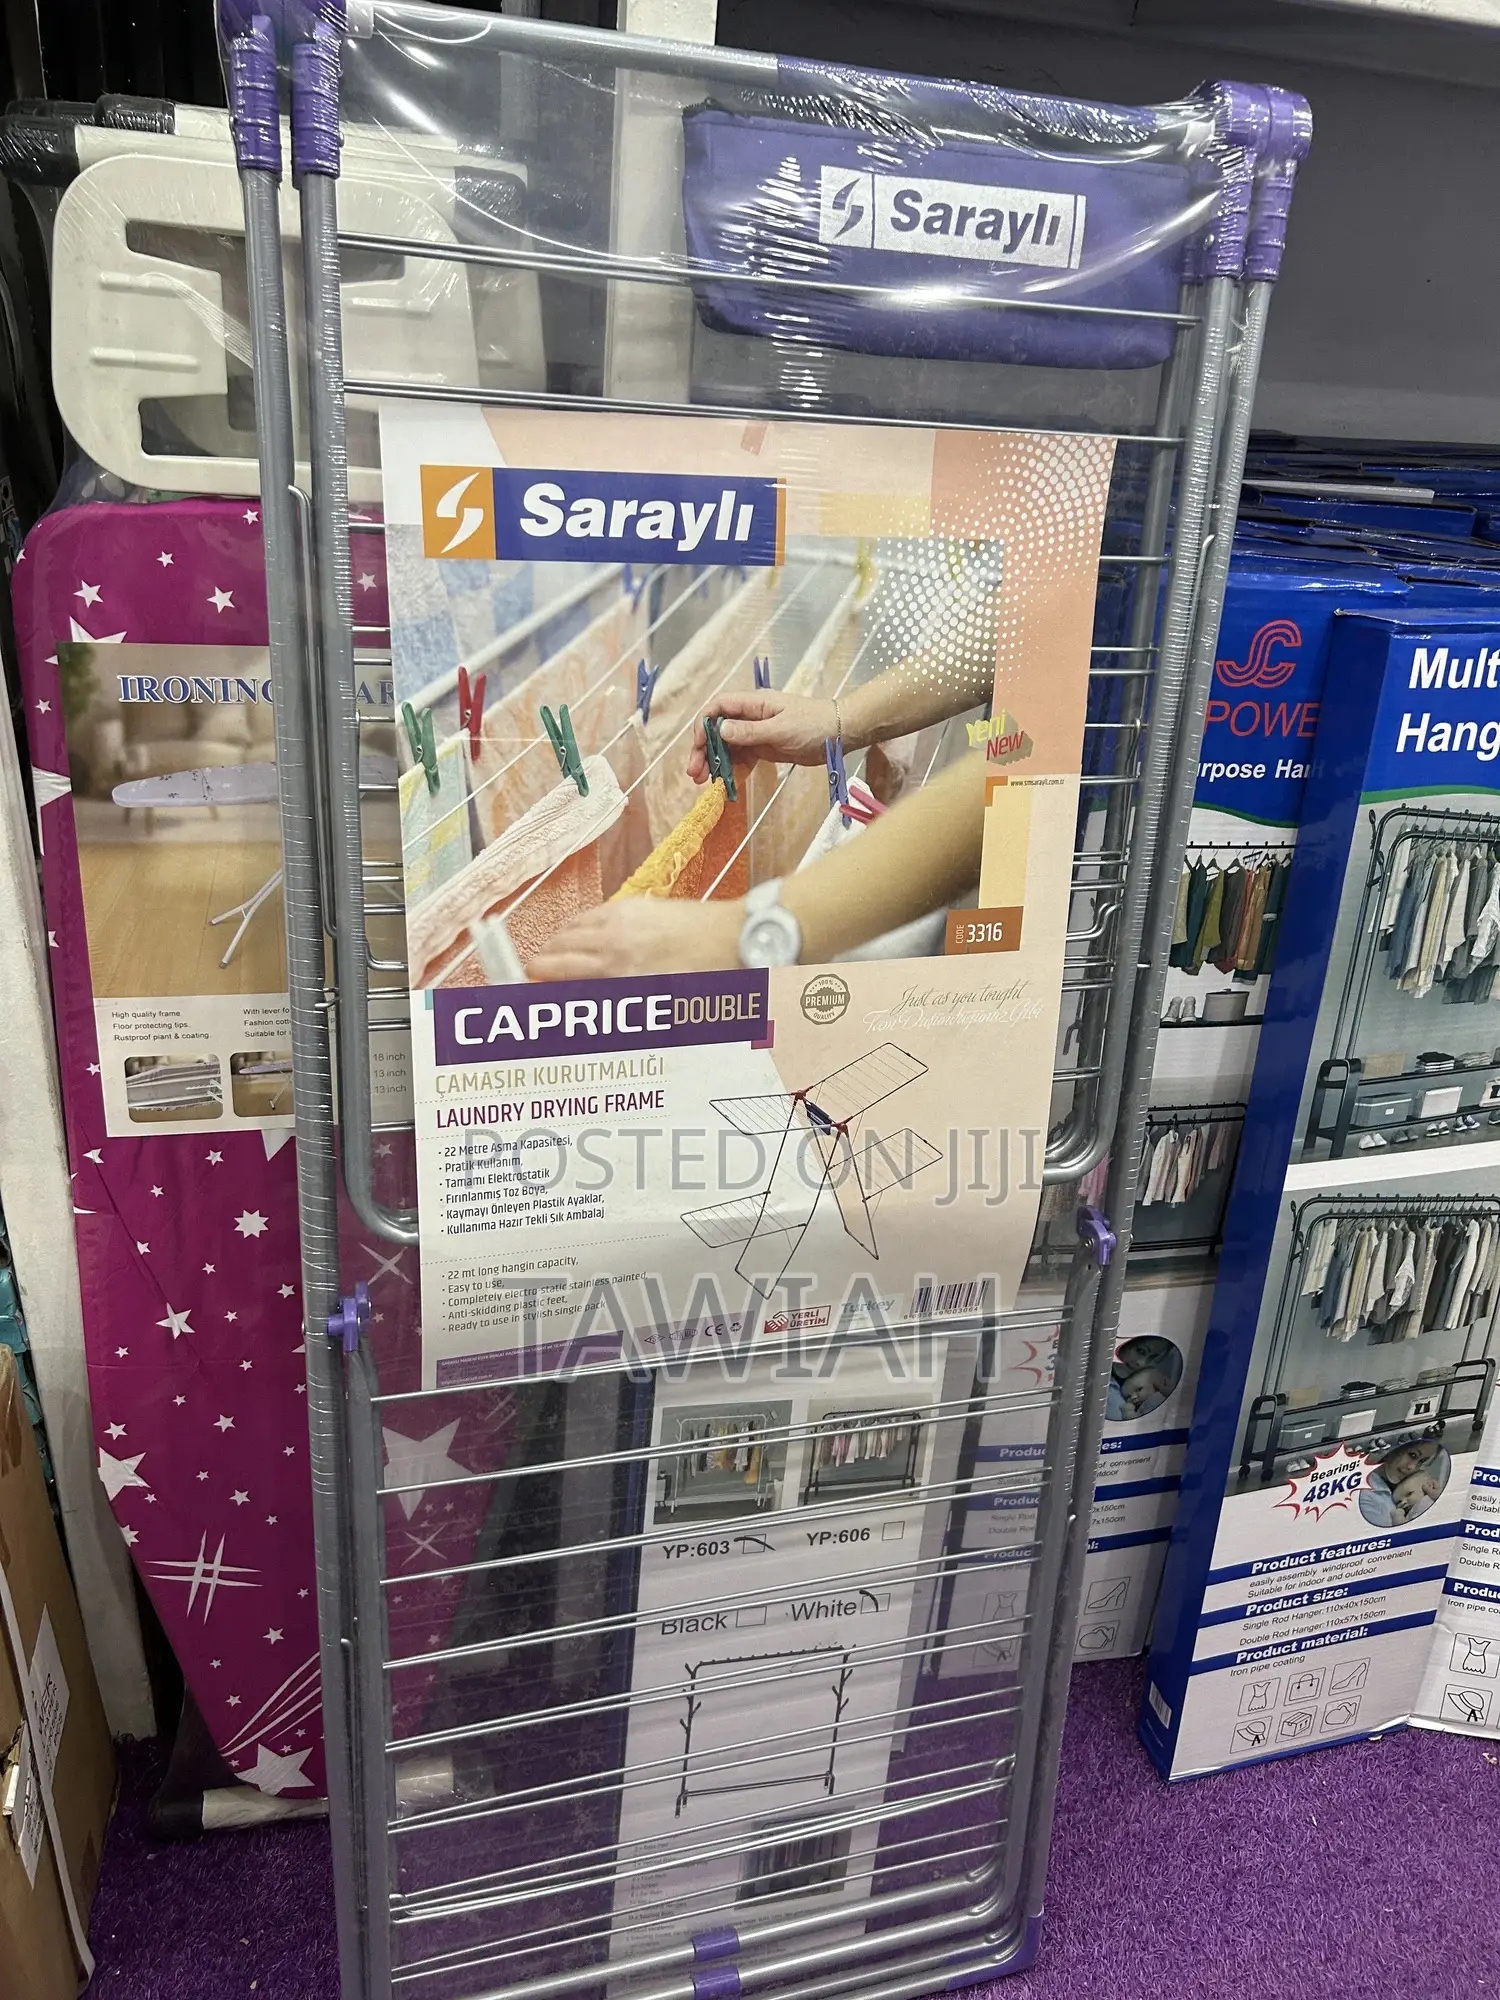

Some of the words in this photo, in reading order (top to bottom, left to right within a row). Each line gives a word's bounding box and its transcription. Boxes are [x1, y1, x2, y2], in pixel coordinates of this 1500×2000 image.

[890, 188, 1061, 254] Saraylı
[520, 482, 755, 552] Saraylı
[1408, 647, 1500, 689] Mult
[1203, 700, 1320, 738] POWE
[1395, 712, 1500, 762] Hang
[955, 924, 965, 944] CODE
[966, 922, 1003, 943] 3316
[805, 993, 845, 1007] PREMIUM
[932, 992, 951, 1007] as
[952, 991, 977, 1013] you
[111, 1011, 130, 1020] High
[131, 1011, 157, 1019] quality
[158, 1010, 181, 1018] frame
[243, 1008, 260, 1016] With
[261, 1007, 282, 1015] lever
[453, 993, 672, 1046] CAPRICE
[673, 991, 762, 1026] DOUBLE
[813, 1011, 835, 1020] QUALITY
[134, 1022, 173, 1030] protecting
[243, 1018, 275, 1027] Fashion
[114, 1033, 152, 1042] Rustproof
[174, 1032, 180, 1040] &
[244, 1029, 275, 1038] Suitable
[276, 1029, 288, 1037] for
[373, 1053, 385, 1062] 18
[386, 1052, 406, 1061] inch
[374, 1069, 386, 1078] 13
[387, 1068, 407, 1078] inch
[435, 1067, 527, 1099] ÇAMAŞIR
[533, 1054, 665, 1087] KURUTMALIĞI
[374, 1085, 386, 1094] 13
[387, 1084, 407, 1094] inch
[436, 1100, 526, 1129] LAUNDRY
[530, 1095, 599, 1121] DRYING
[604, 1089, 665, 1114] FRAME
[444, 1146, 457, 1157] 22
[459, 1143, 489, 1156] Metre
[490, 1141, 518, 1153] Asma
[520, 1134, 573, 1150] Kapasitesi,
[445, 1160, 475, 1173] Pratik
[445, 1175, 486, 1188] Tamamı
[488, 1168, 550, 1184] Elektrostatik
[446, 1189, 501, 1204] Fırınlanmış
[503, 1186, 520, 1198] Toz
[522, 1184, 548, 1197] Boya,
[446, 1207, 489, 1220] Kaymayı
[491, 1202, 530, 1216] Önleyen
[533, 1197, 565, 1209] Plastik
[567, 1192, 605, 1207] Ayaklar,
[447, 1219, 496, 1235] Kullanıma
[499, 1216, 524, 1229] Hazır
[525, 1213, 548, 1226] Tekli
[566, 1206, 605, 1221] Ambalaj
[448, 1270, 459, 1280] 22
[462, 1268, 476, 1278] mt
[478, 1265, 499, 1277] long
[502, 1261, 535, 1275] hangin
[537, 1255, 579, 1270] capacity,
[448, 1282, 470, 1294] Easy
[472, 1280, 483, 1290] to
[448, 1291, 502, 1307] Completely
[569, 1277, 610, 1291] stainless
[448, 1303, 512, 1320] Anti-skidding
[513, 1298, 545, 1312] plastic
[547, 1294, 568, 1305] feet,
[791, 1308, 820, 1320] YERLİ
[841, 1299, 896, 1313] Turkey
[448, 1320, 478, 1333] Ready
[480, 1318, 490, 1328] to
[492, 1315, 509, 1326] use
[511, 1313, 520, 1323] in
[522, 1308, 553, 1321] stylish
[555, 1304, 583, 1317] single
[789, 1316, 826, 1328] ÜRETİM
[999, 1446, 1046, 1458] Produc
[1309, 1459, 1361, 1483] Bearing:
[1302, 1471, 1362, 1503] 48KG
[993, 1495, 1040, 1507] Produc
[1471, 1494, 1497, 1505] easily
[1464, 1523, 1500, 1538] Prod
[662, 1540, 731, 1560] YP:603
[806, 1527, 872, 1547] YP:606
[1461, 1543, 1490, 1555] Single
[1251, 1552, 1317, 1575] Product
[1320, 1537, 1392, 1562] features:
[1459, 1557, 1491, 1569] Double
[1249, 1575, 1275, 1588] easily
[1276, 1567, 1318, 1583] assembly
[1322, 1558, 1364, 1574] windproof
[1367, 1548, 1413, 1565] convenient
[1247, 1585, 1283, 1599] Suitable
[1284, 1581, 1297, 1591] for
[1298, 1575, 1325, 1588] indoor
[1326, 1571, 1344, 1583] and
[1345, 1566, 1378, 1579] outdoor
[1245, 1594, 1309, 1616] Product
[1312, 1586, 1349, 1603] size:
[1447, 1598, 1465, 1609] Iron
[1466, 1601, 1486, 1613] pipe
[660, 1612, 729, 1636] Black
[791, 1600, 858, 1622] White
[1242, 1619, 1270, 1631] Single
[1271, 1614, 1290, 1625] Rod
[1235, 1642, 1298, 1664] Product
[1300, 1626, 1369, 1650] material:
[1239, 1634, 1270, 1647] Double
[1271, 1628, 1290, 1639] Rod
[1230, 1666, 1249, 1677] Iron
[1250, 1661, 1271, 1674] pipe
[1272, 1654, 1306, 1669] coating
